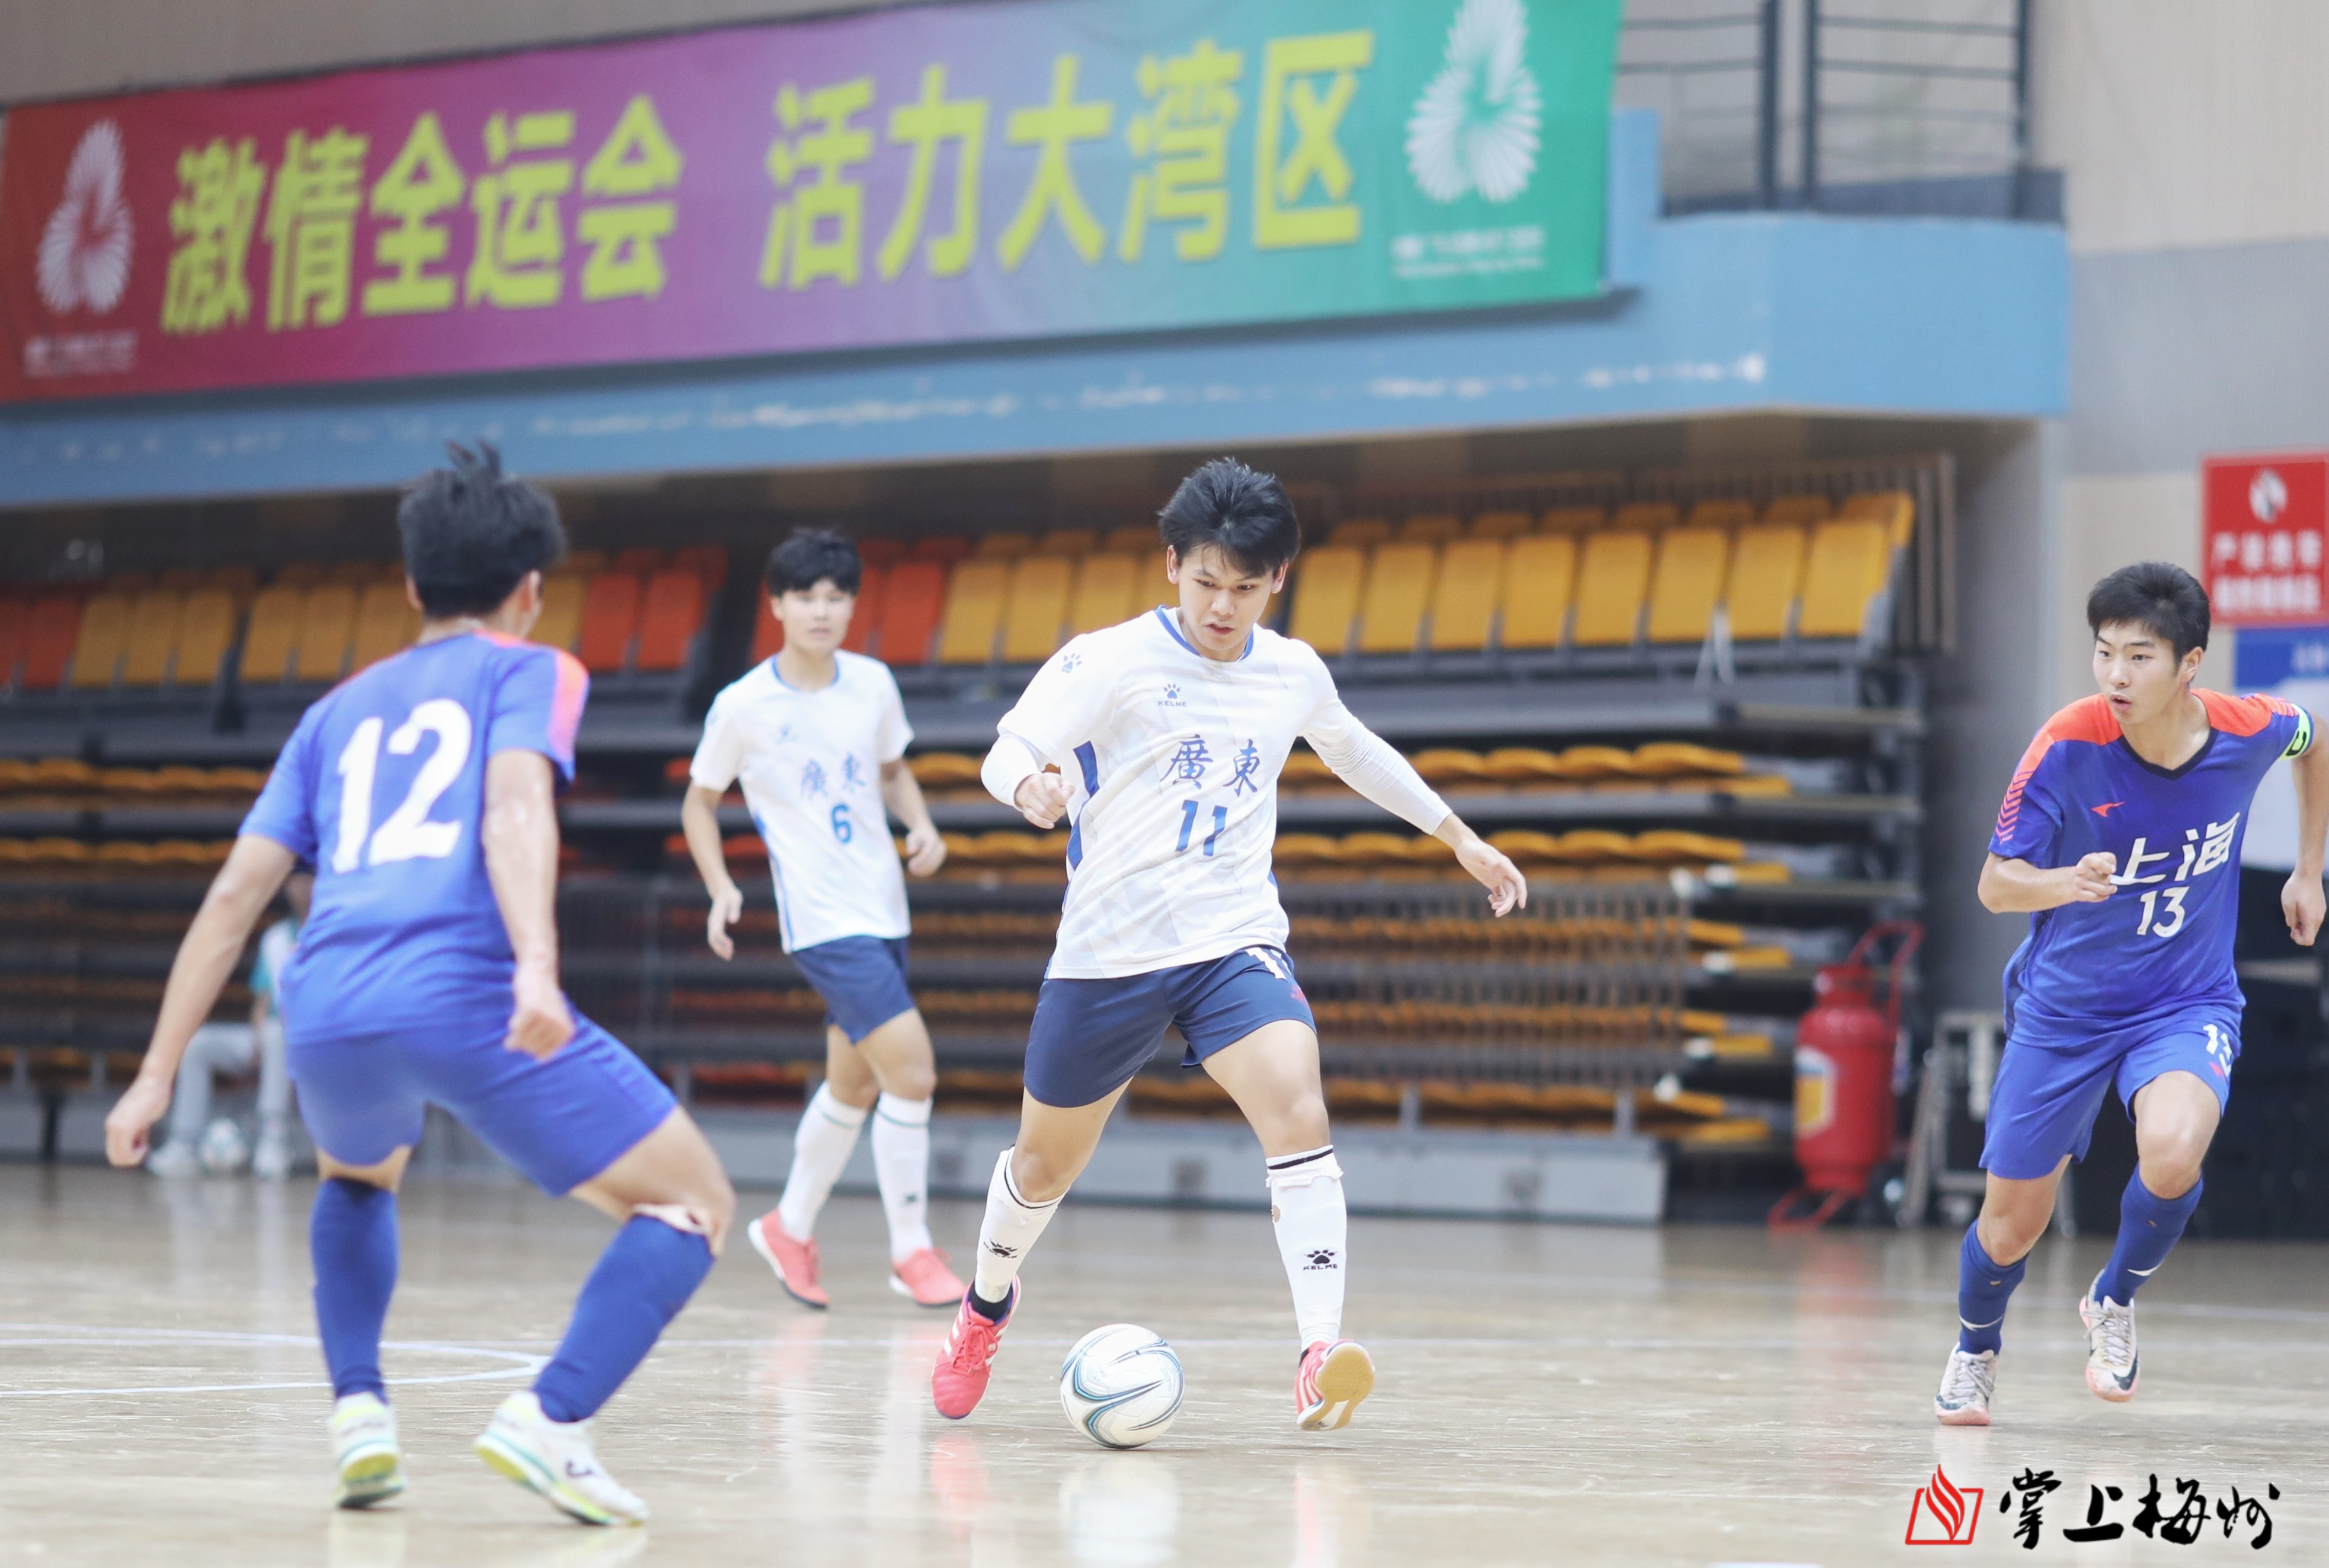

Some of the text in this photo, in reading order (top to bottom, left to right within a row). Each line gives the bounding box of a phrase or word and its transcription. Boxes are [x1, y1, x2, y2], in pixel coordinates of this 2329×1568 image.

[161, 30, 1373, 334] 激情全运会 活力大湾区
[332, 698, 472, 874] 12
[1160, 734, 1261, 797] 廣東
[831, 804, 852, 843] 6
[1175, 799, 1227, 856] 11
[2110, 812, 2240, 885] 上海
[2136, 886, 2189, 938] 13
